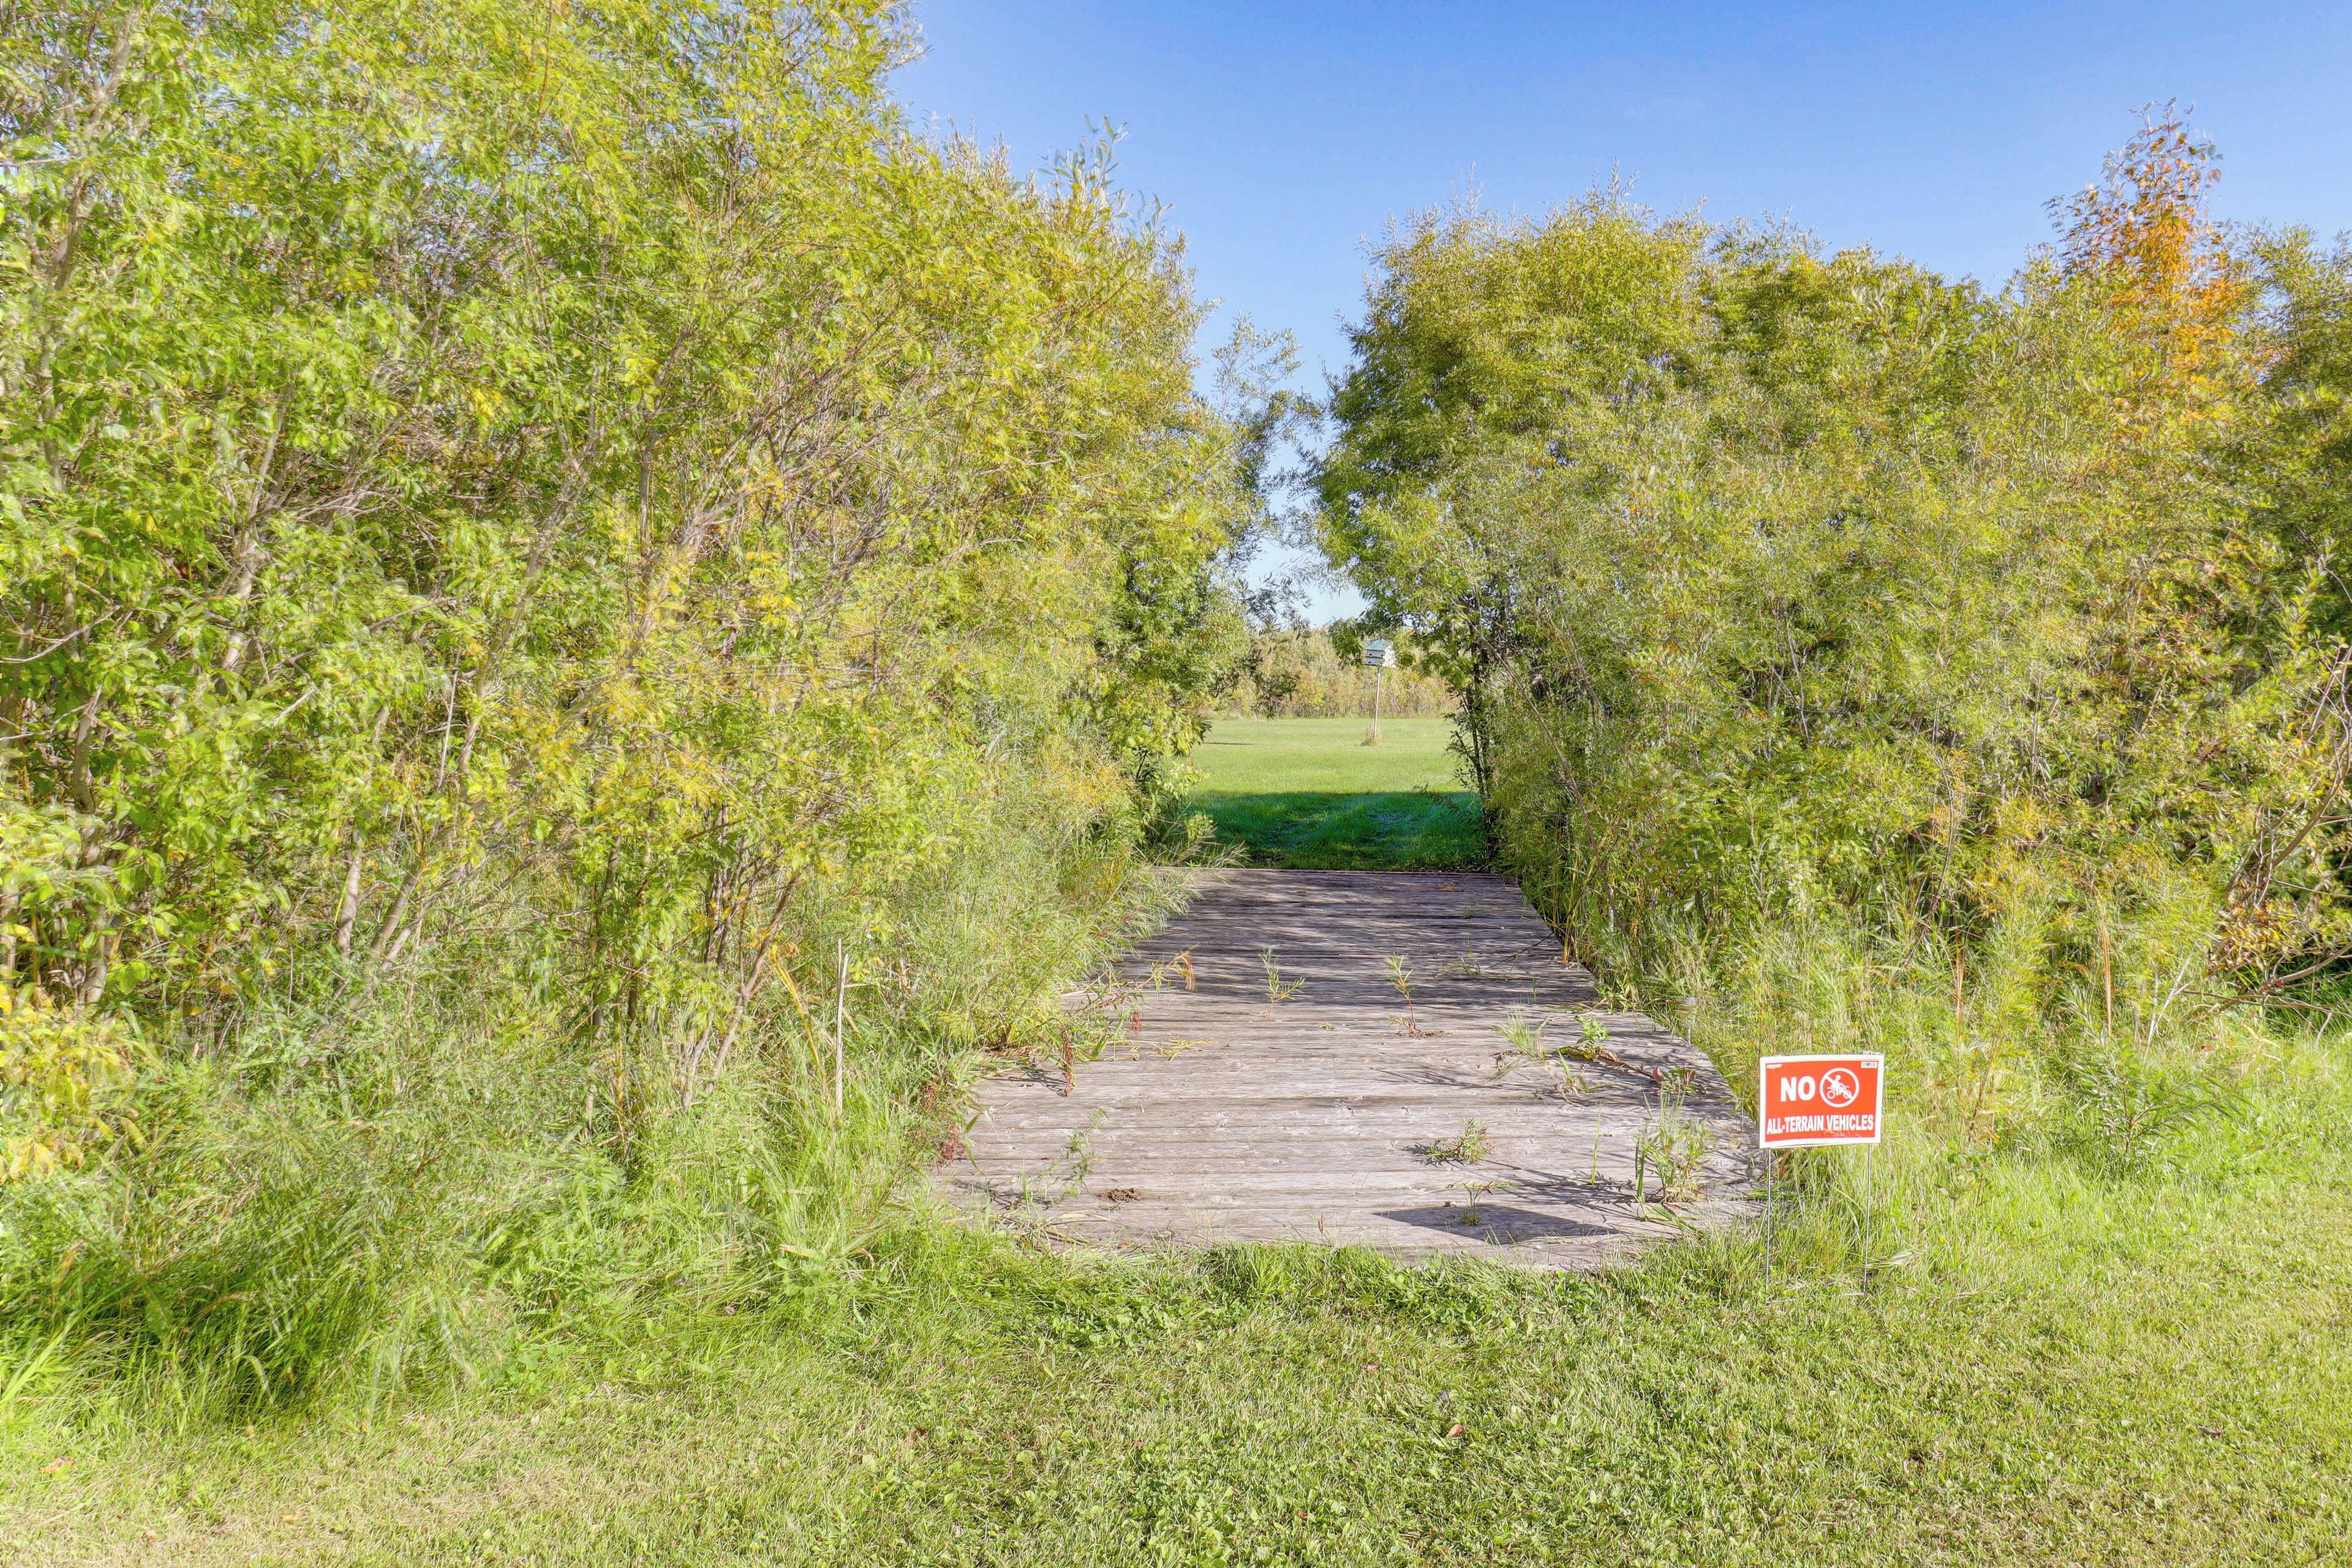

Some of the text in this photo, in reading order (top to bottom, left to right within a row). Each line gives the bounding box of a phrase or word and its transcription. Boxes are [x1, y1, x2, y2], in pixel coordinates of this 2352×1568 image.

[1781, 1076, 1815, 1102] NO
[1766, 1114, 1874, 1134] ALL-TERRAIN VEHICLES
